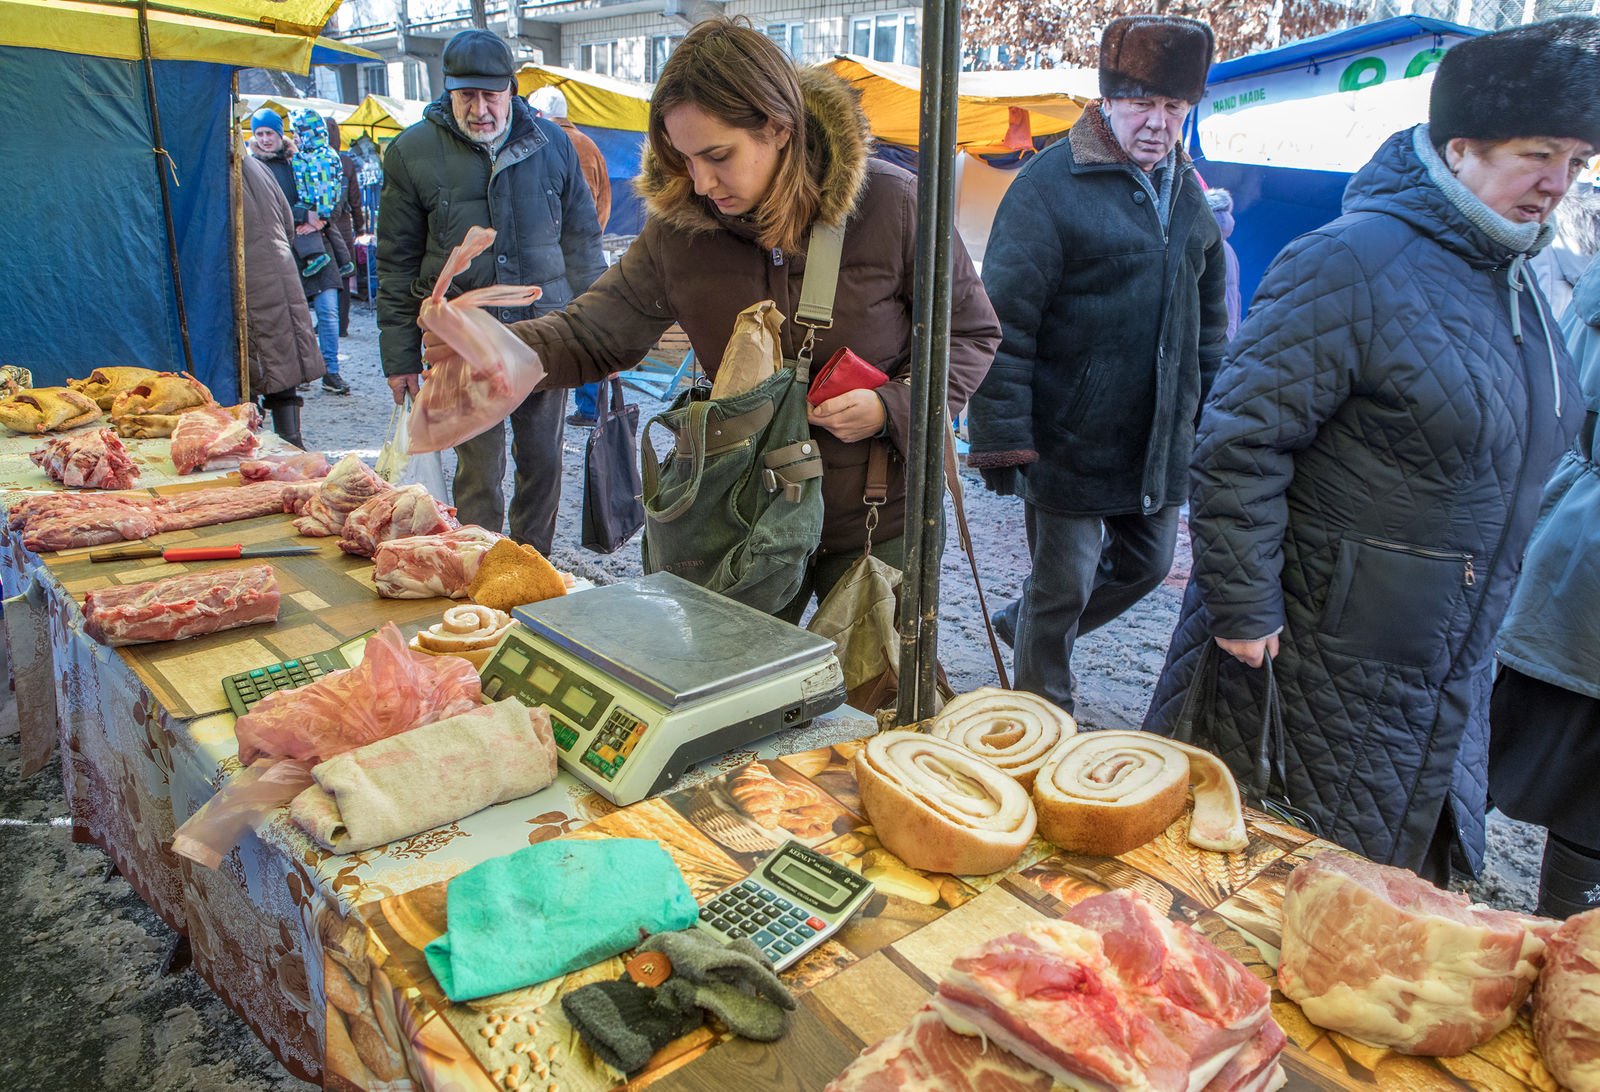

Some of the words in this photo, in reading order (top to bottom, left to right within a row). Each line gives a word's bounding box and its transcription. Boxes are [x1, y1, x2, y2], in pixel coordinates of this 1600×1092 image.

[1213, 96, 1236, 113] HAND
[1239, 88, 1266, 106] MADE
[789, 848, 813, 863] KEENLY
